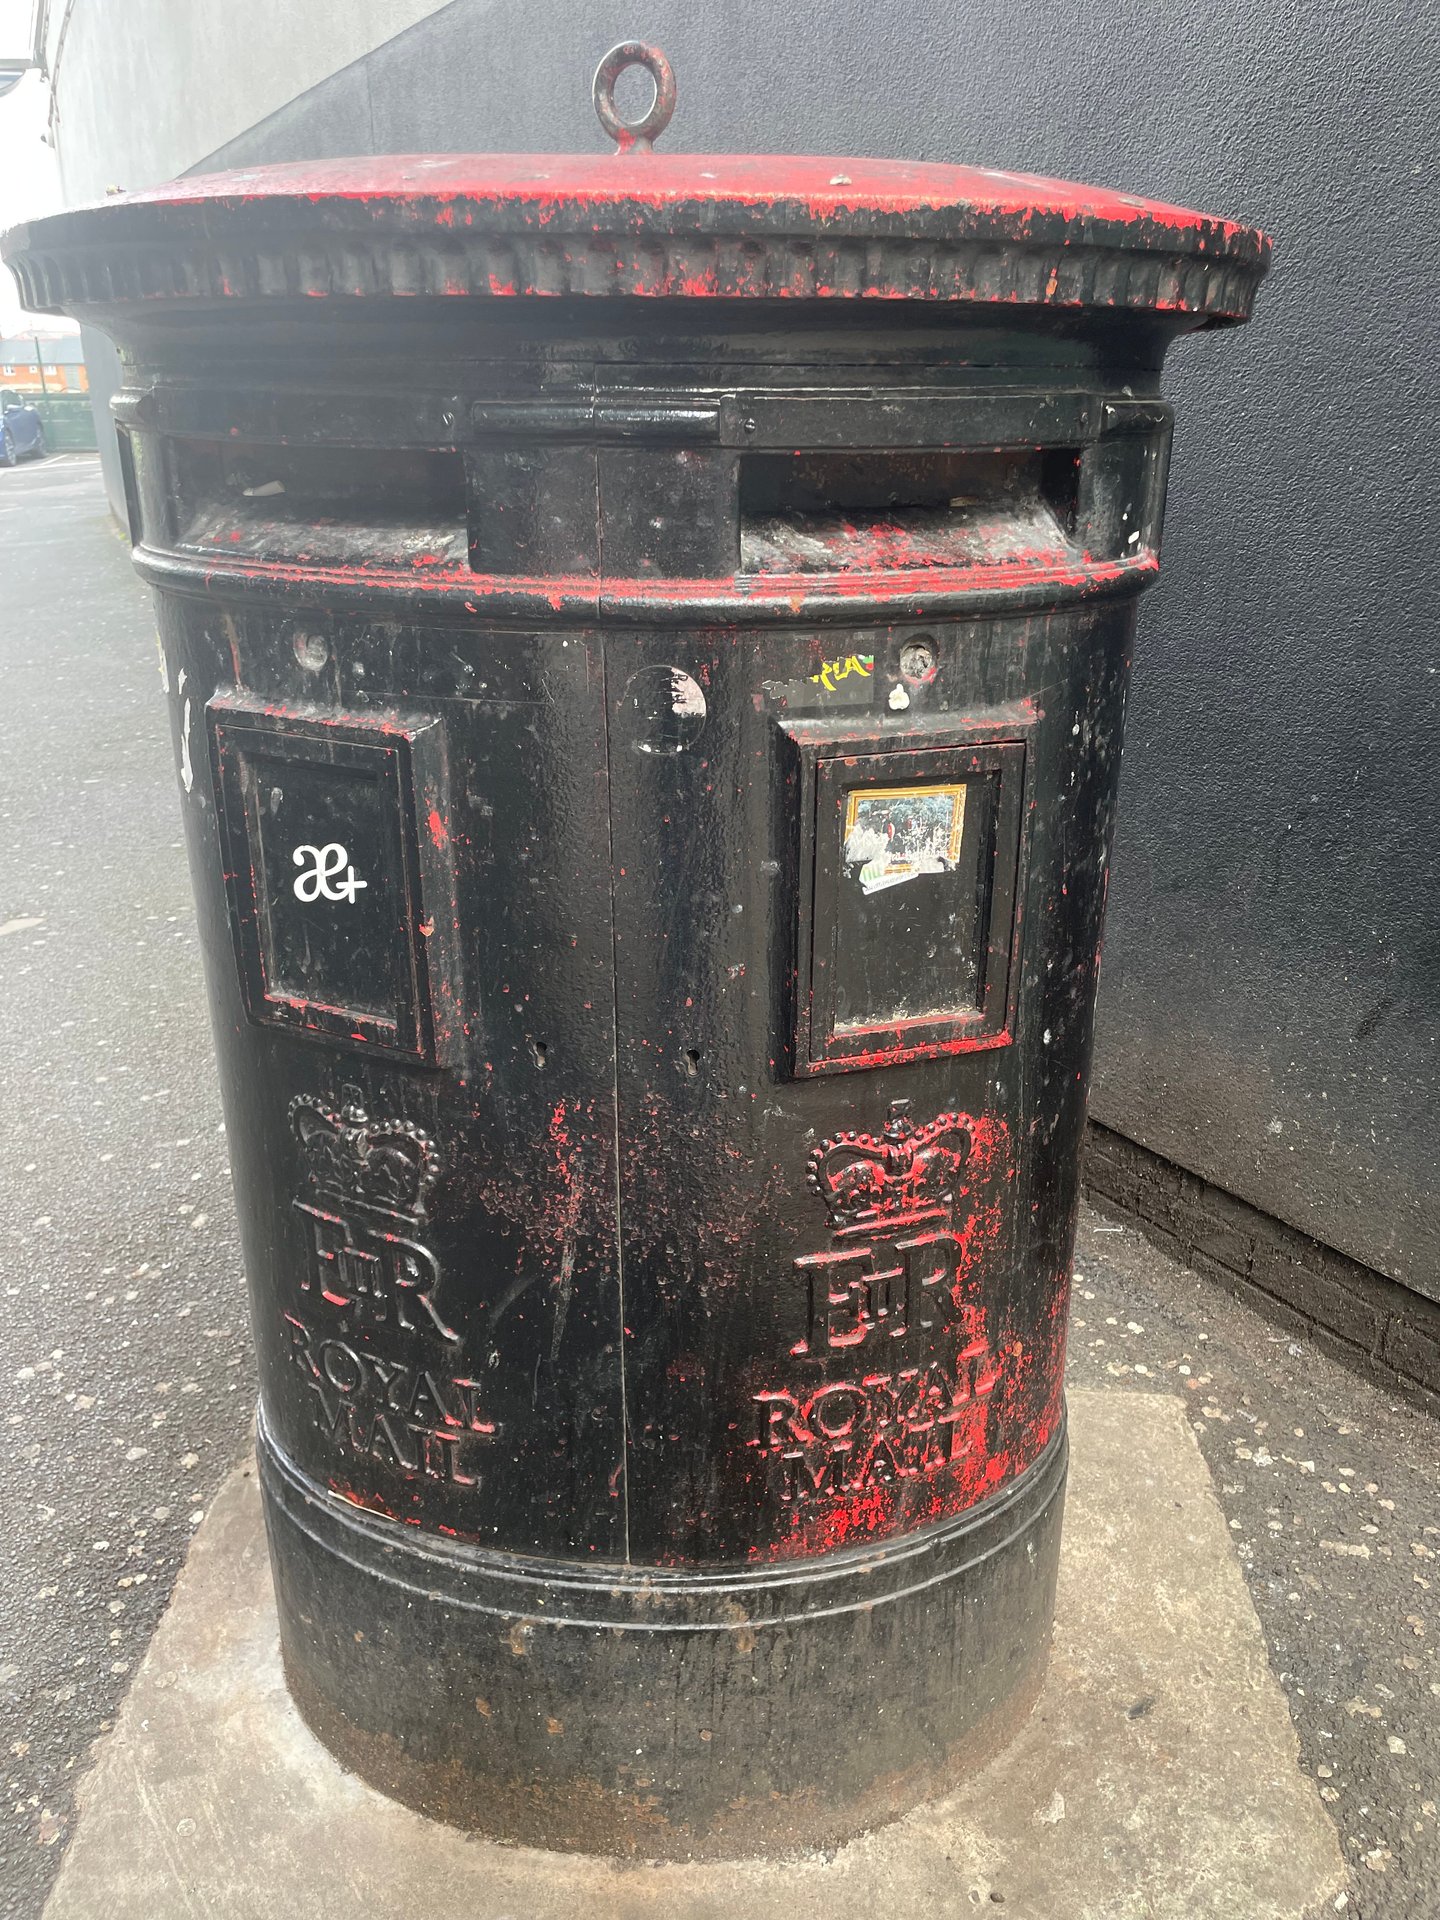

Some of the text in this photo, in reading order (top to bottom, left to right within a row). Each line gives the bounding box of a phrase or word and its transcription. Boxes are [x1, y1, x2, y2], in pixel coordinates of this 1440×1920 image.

[283, 1312, 497, 1435] ROYAL
[745, 1343, 998, 1447] ROYAL
[305, 1382, 482, 1487] MAIL
[778, 1411, 973, 1500] MAIL
